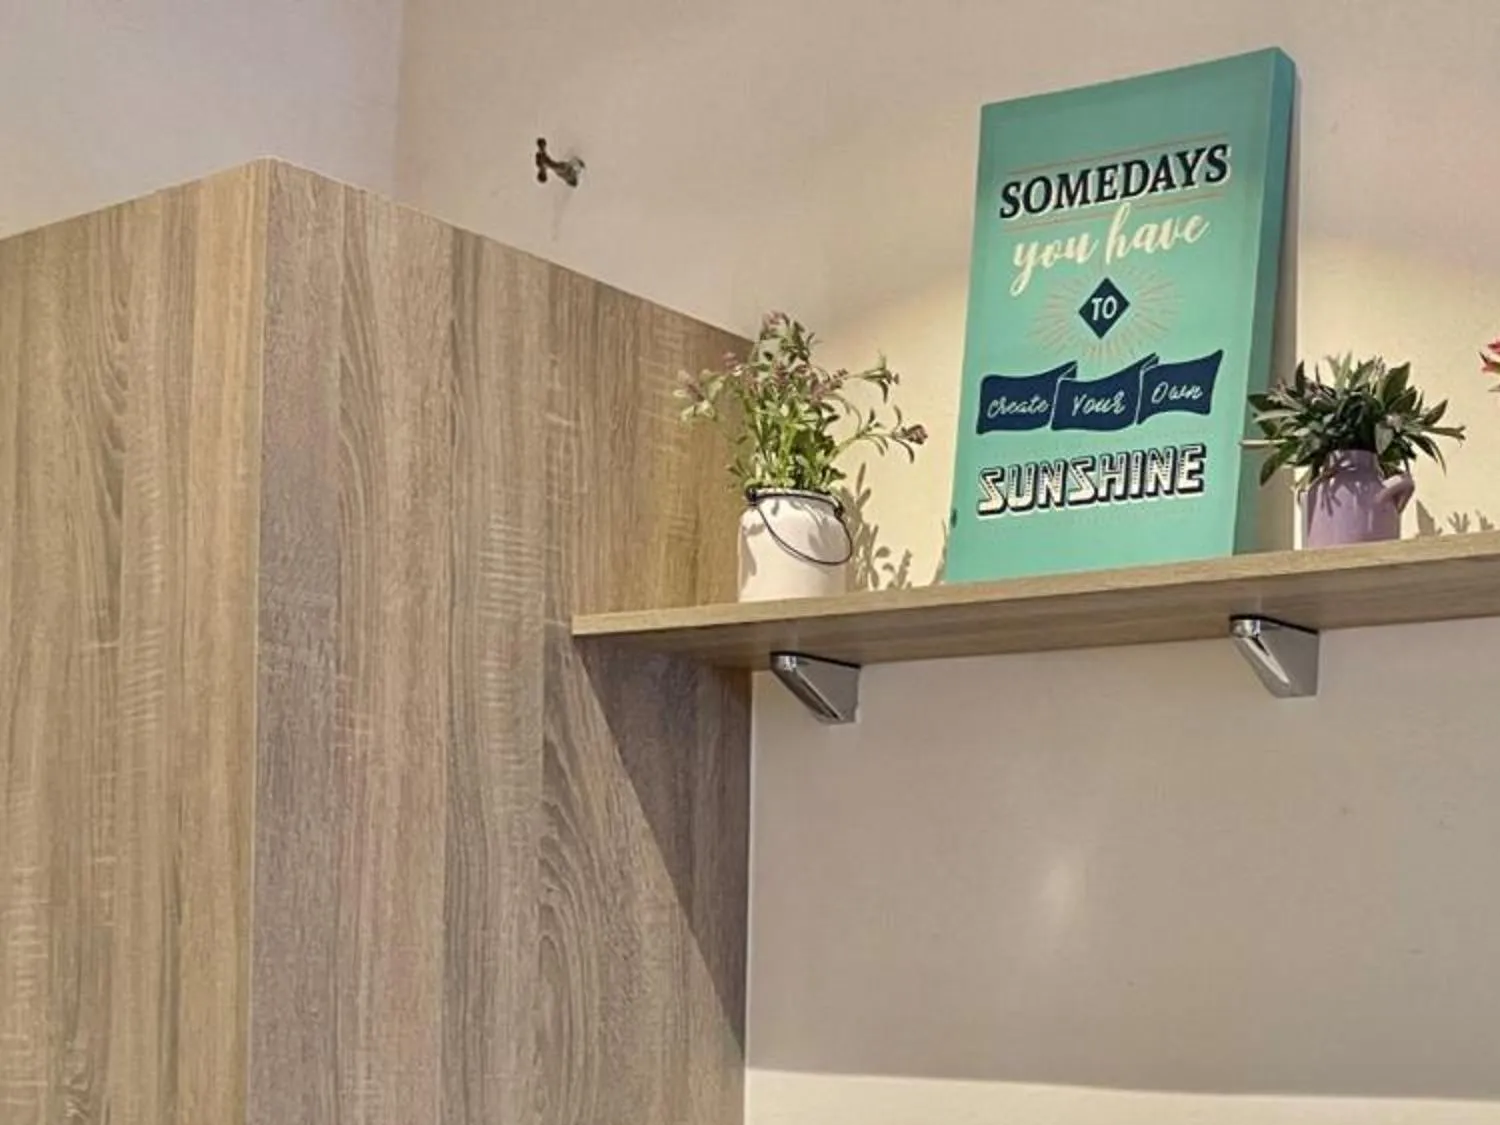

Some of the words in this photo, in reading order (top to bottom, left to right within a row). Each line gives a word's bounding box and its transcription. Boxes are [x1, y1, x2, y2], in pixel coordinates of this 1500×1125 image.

[1000, 143, 1231, 219] SOMEDAYS
[1010, 232, 1097, 297] you
[1105, 203, 1210, 265] have
[1091, 296, 1117, 321] TO
[1071, 390, 1126, 417] Your
[1151, 381, 1203, 404] Own
[976, 443, 1207, 516] SUNSHINE
